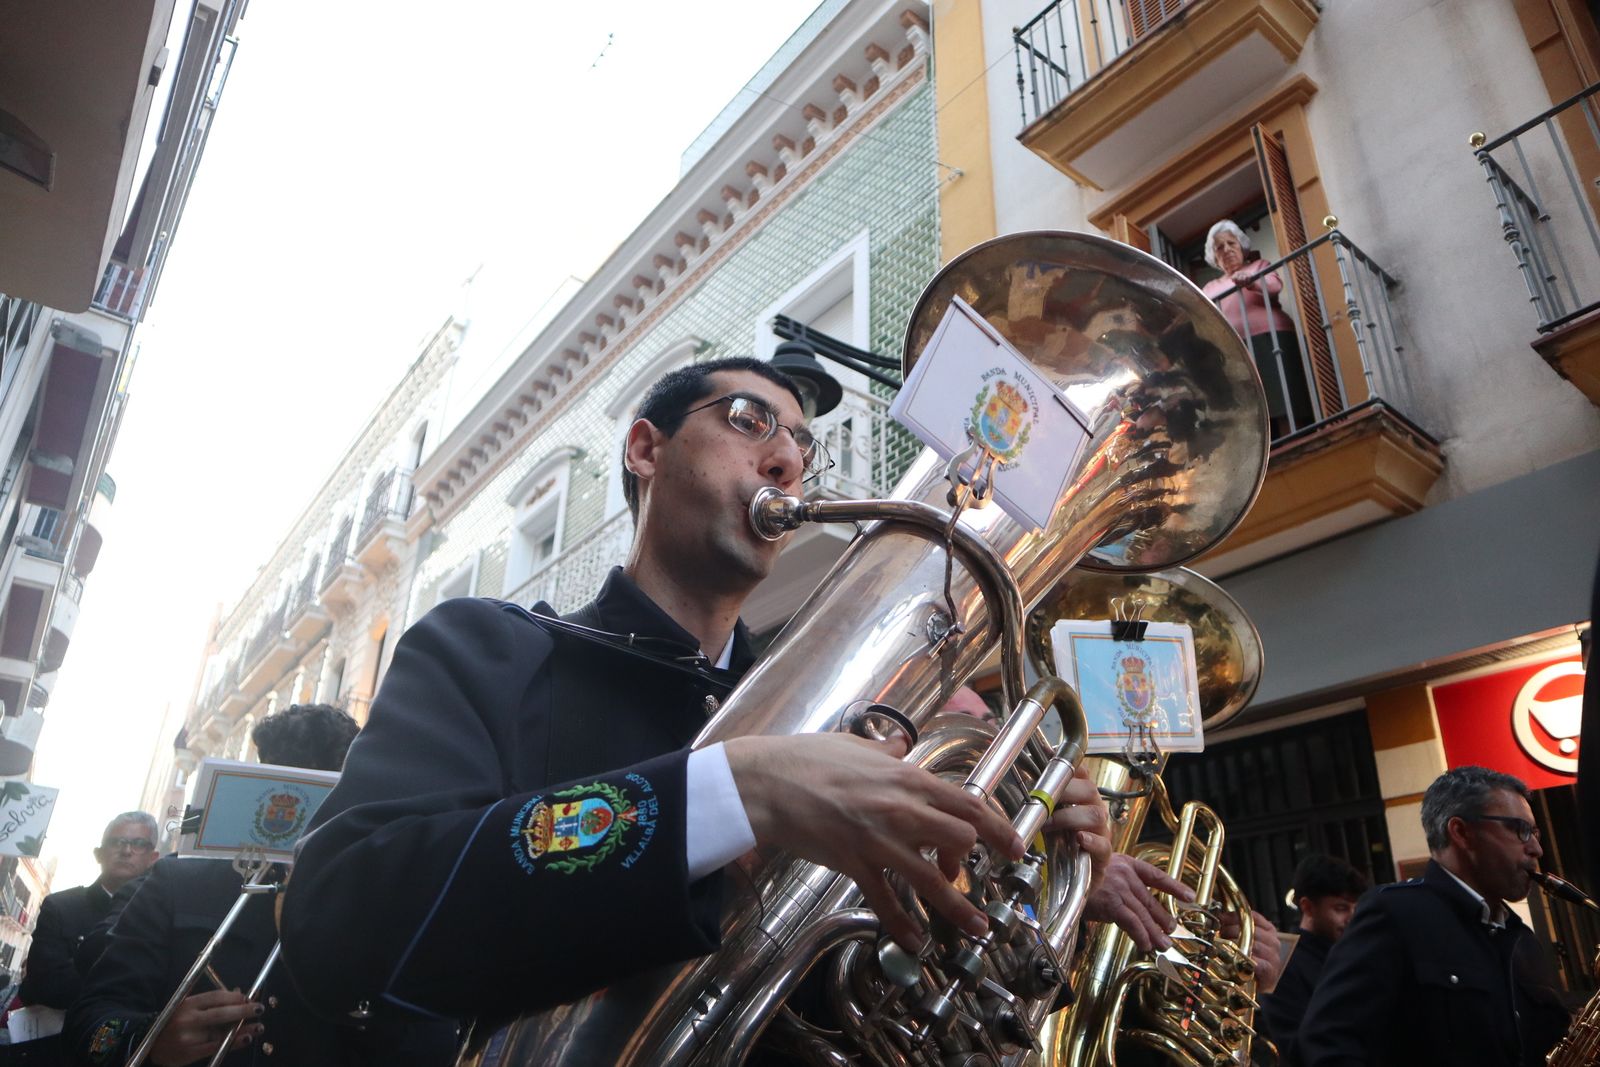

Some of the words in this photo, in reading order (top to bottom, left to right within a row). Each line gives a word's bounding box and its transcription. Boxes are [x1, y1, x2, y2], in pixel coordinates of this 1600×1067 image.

[981, 367, 1007, 382] BANDA
[1014, 371, 1040, 425] MUNICIPAL
[625, 771, 653, 792] ALCOR
[510, 795, 544, 837] MUNICIPAL
[637, 800, 648, 826] 1880
[647, 794, 660, 816] DEL
[511, 839, 534, 875] BANDA
[621, 819, 657, 869] VILLALBA
